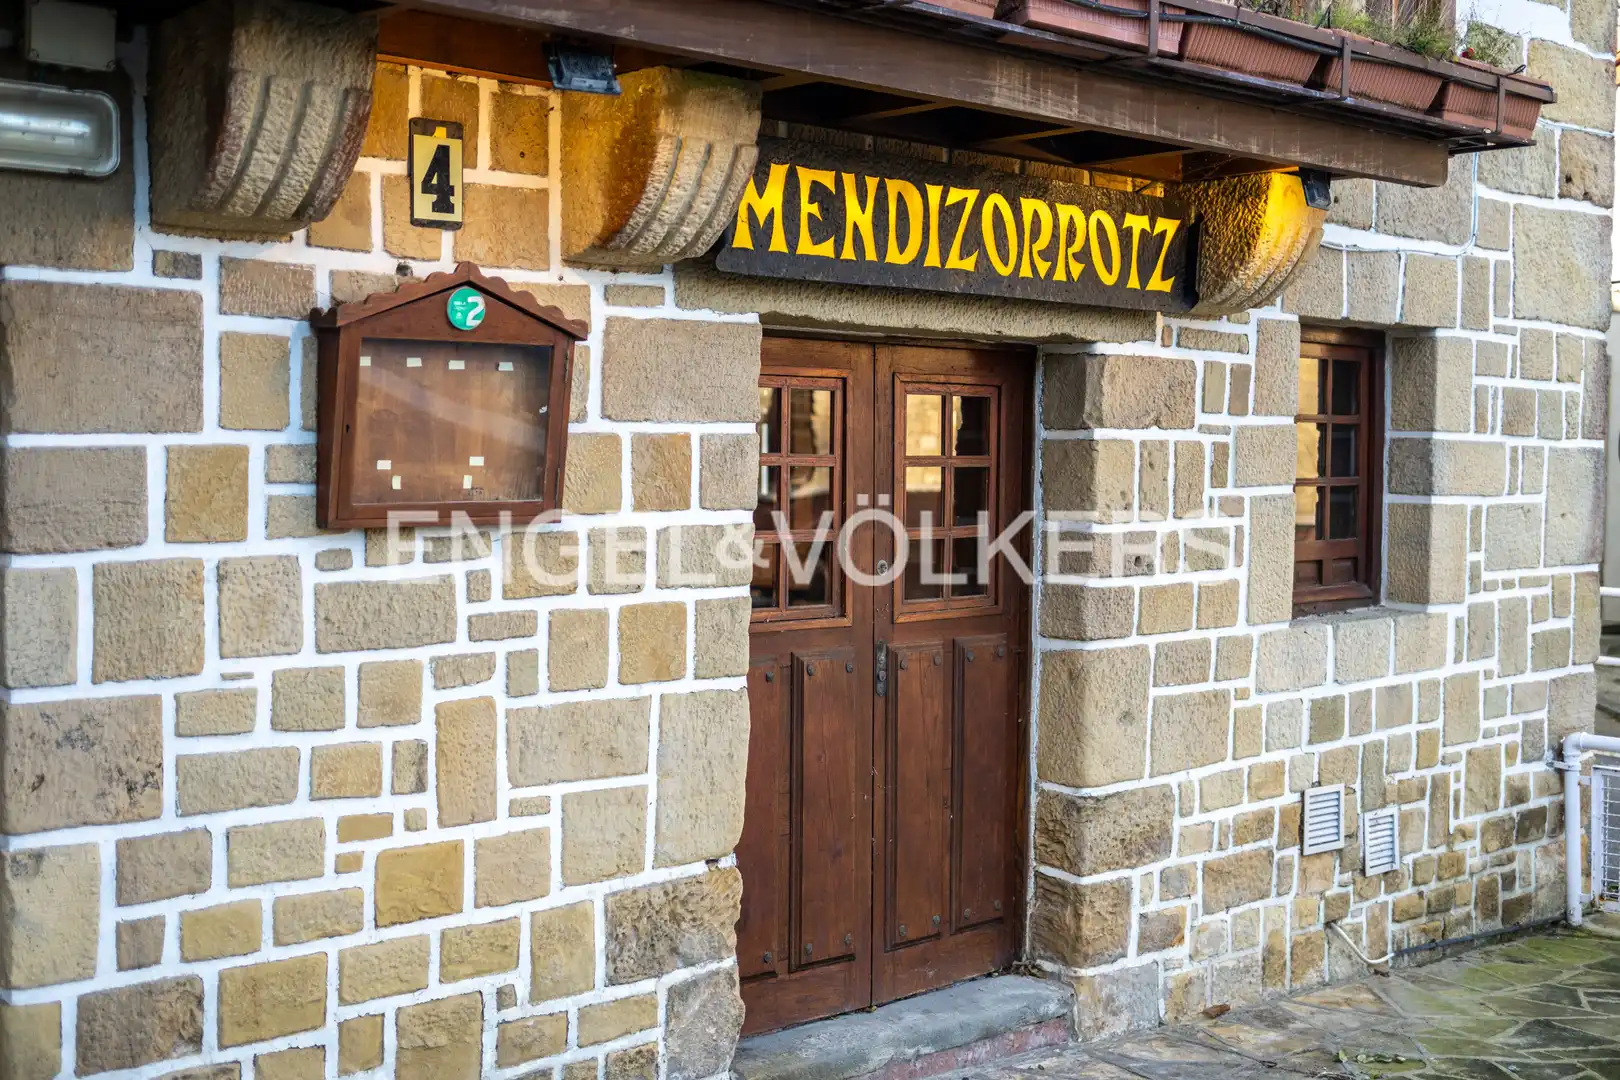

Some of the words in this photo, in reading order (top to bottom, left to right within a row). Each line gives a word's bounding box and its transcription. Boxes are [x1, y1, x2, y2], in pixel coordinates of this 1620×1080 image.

[421, 144, 455, 214] 4
[732, 163, 1181, 293] MENDIZORROTZ
[466, 296, 485, 326] 2
